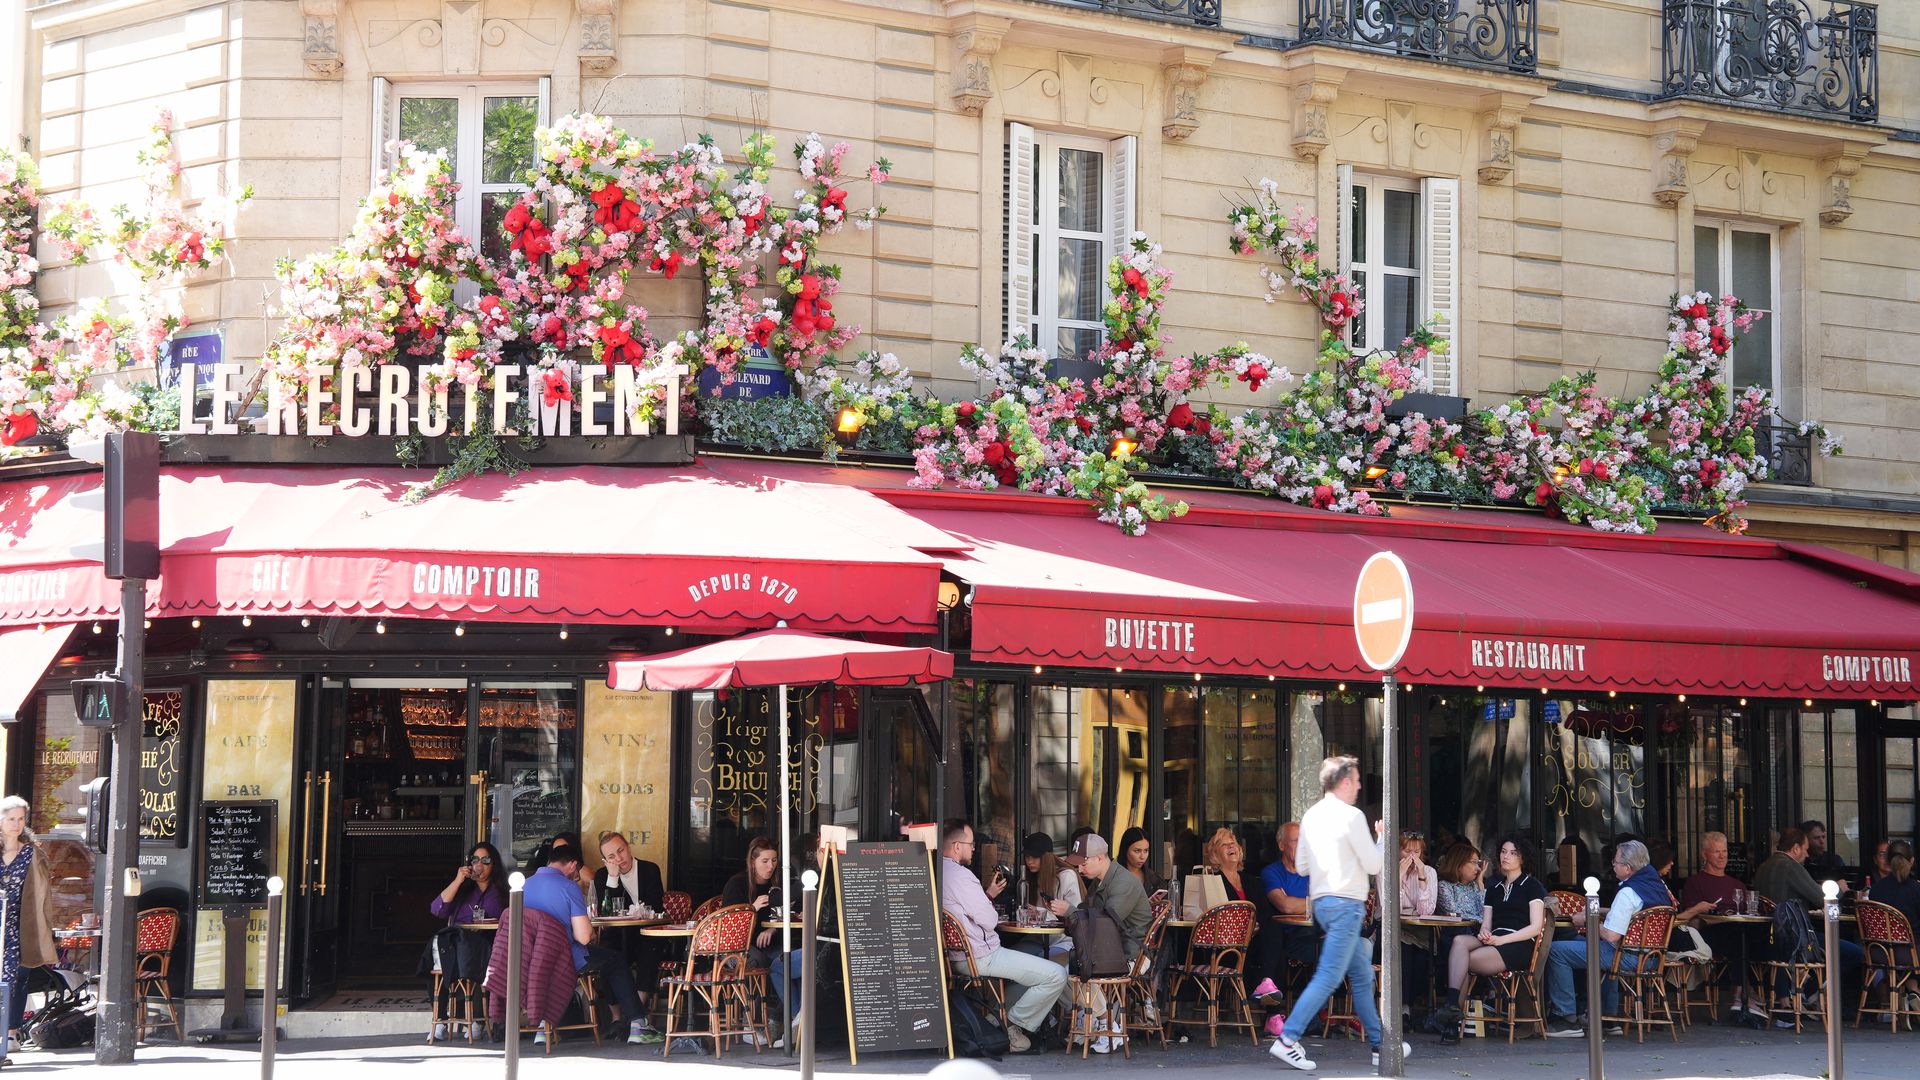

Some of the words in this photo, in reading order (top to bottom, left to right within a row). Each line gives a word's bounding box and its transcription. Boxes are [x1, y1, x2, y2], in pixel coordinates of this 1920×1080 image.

[182, 346, 199, 358] RUE
[180, 363, 243, 435] LE
[739, 386, 752, 397] DE
[412, 562, 541, 598] COMPTOIR
[687, 572, 752, 602] DEPUIS
[759, 575, 799, 605] 1870
[1104, 616, 1196, 653] BUVETTE
[1471, 639, 1586, 671] RESTAURANT
[1822, 655, 1911, 683] COMPTOIR
[760, 694, 769, 713] à
[602, 733, 656, 747] VINS
[52, 750, 98, 765] RECRUTEMENT
[227, 784, 262, 796] BAR
[599, 783, 654, 795] SODAS
